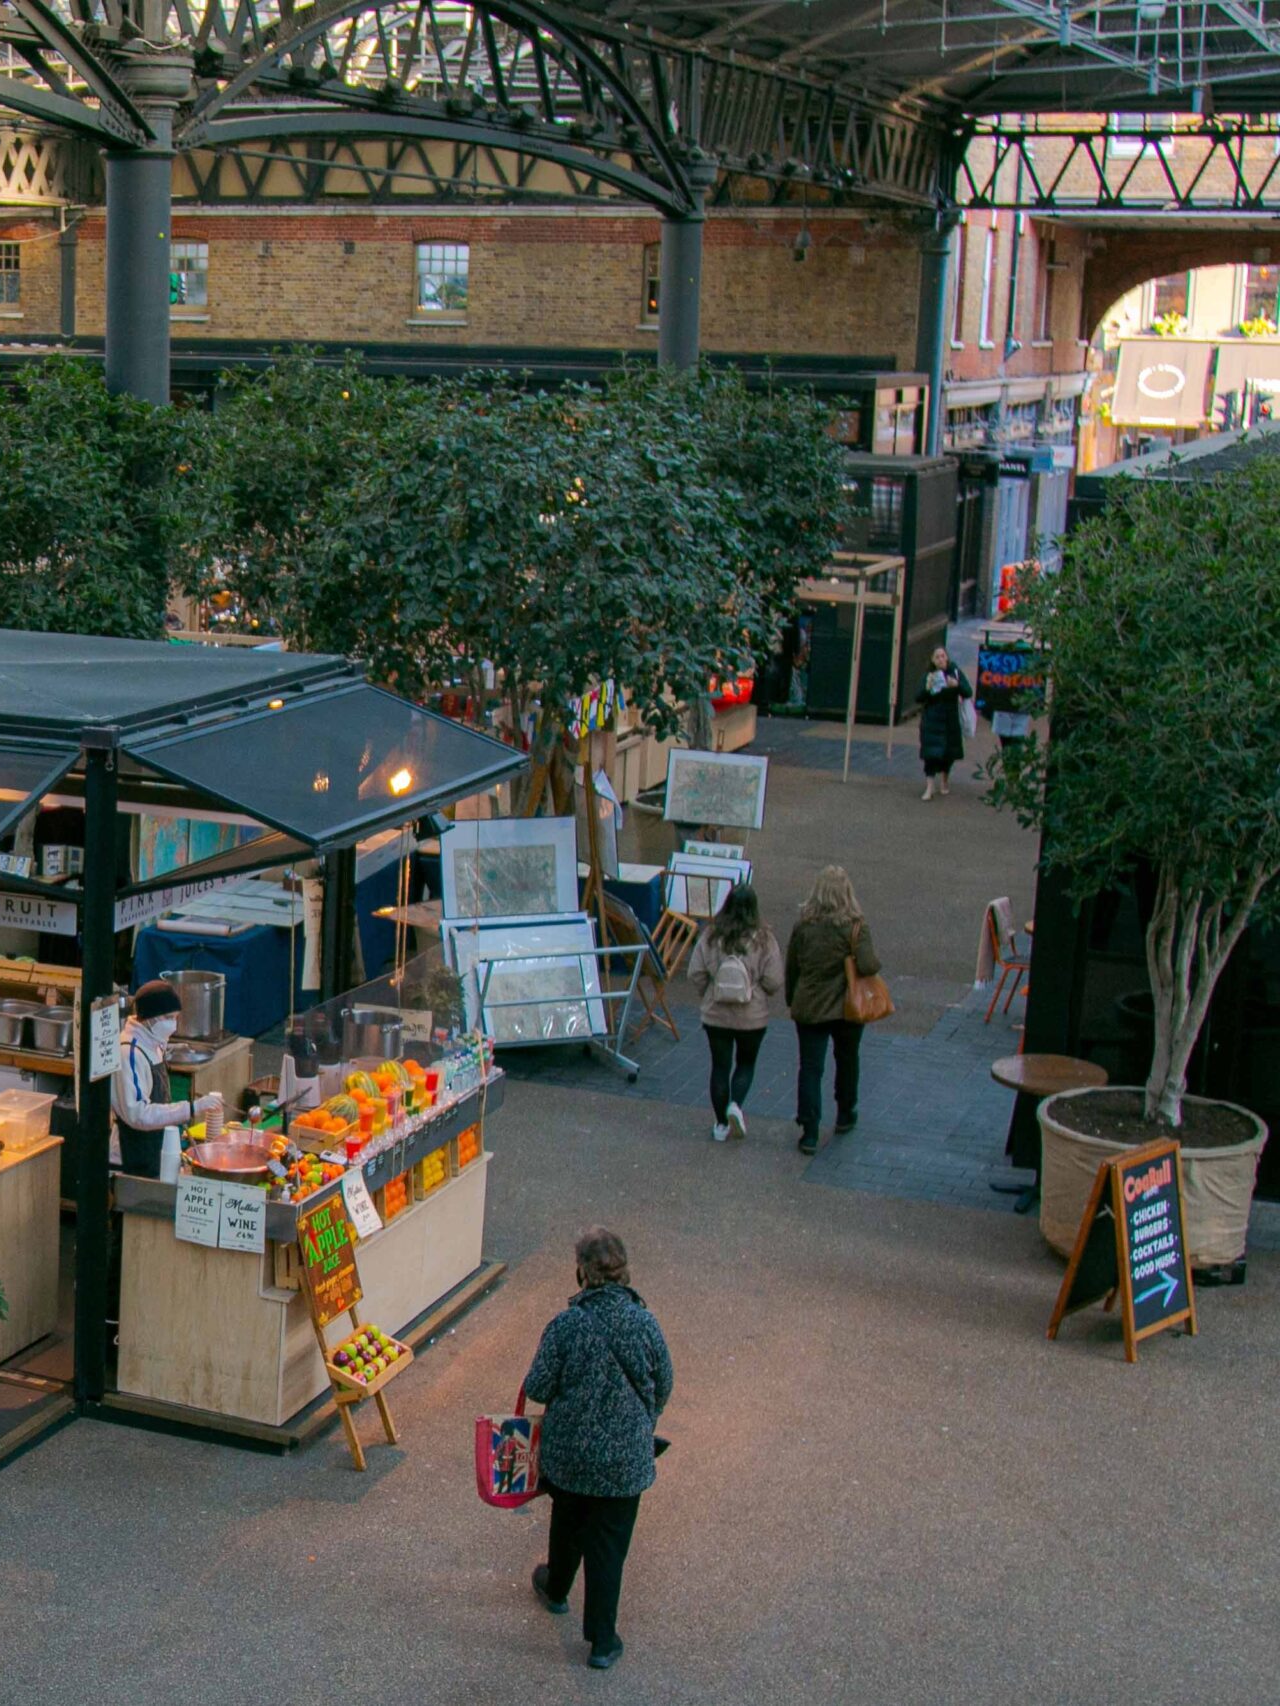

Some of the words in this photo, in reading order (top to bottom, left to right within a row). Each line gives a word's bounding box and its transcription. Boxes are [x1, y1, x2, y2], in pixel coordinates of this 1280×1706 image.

[998, 461, 1027, 473] HANEL
[121, 893, 155, 915] PINK
[184, 1193, 214, 1207] APPLE
[191, 1185, 208, 1194] HOT
[187, 1205, 208, 1215] JUICE
[311, 1206, 331, 1232] HOT
[1133, 1200, 1168, 1226] CHICKEN
[228, 1217, 257, 1231] WINE
[1134, 1217, 1169, 1244] BURGERS
[304, 1219, 349, 1268] APPLE
[1132, 1233, 1175, 1262] COCKTAILS
[1134, 1260, 1155, 1280] GOOD
[1154, 1251, 1177, 1273] MUSIC
